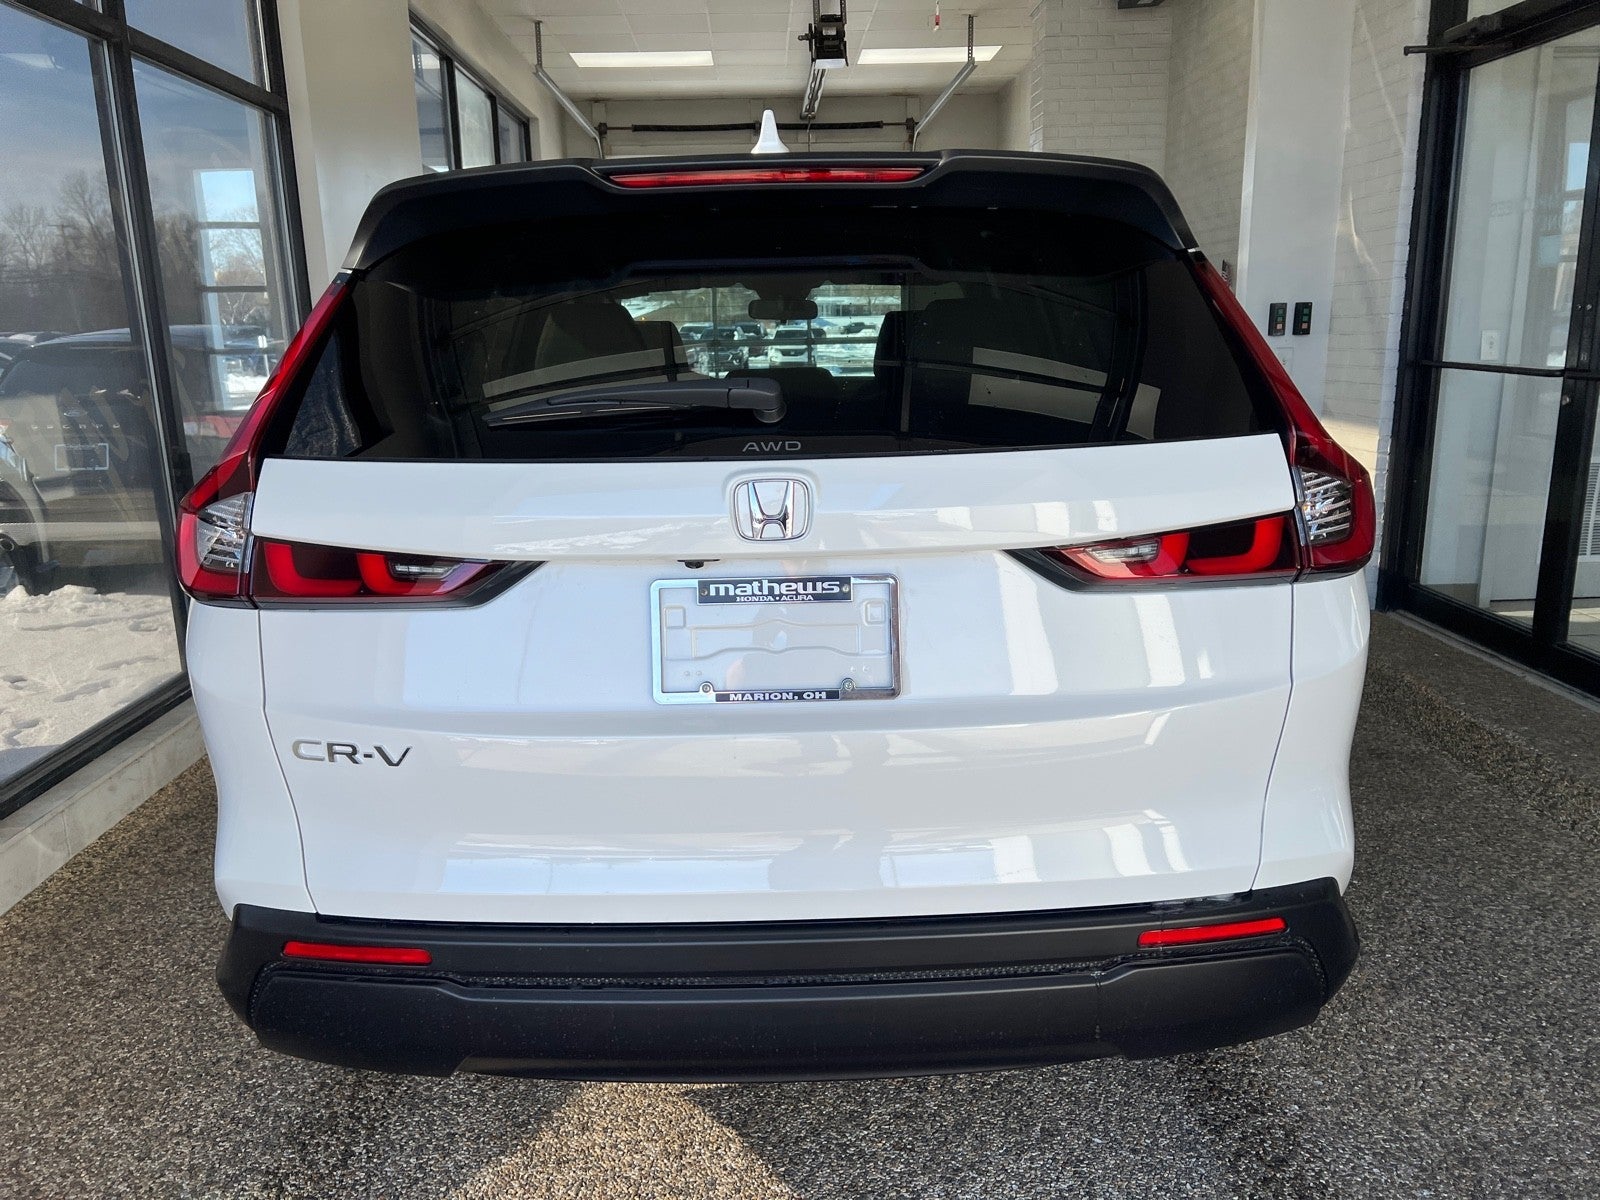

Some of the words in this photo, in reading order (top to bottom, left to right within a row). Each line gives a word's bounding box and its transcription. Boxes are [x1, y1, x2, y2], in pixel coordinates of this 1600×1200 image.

[742, 441, 802, 452] AWD
[709, 579, 840, 596] mathews
[729, 692, 799, 701] MARION,
[802, 691, 827, 700] OH
[292, 738, 413, 767] CR-V
